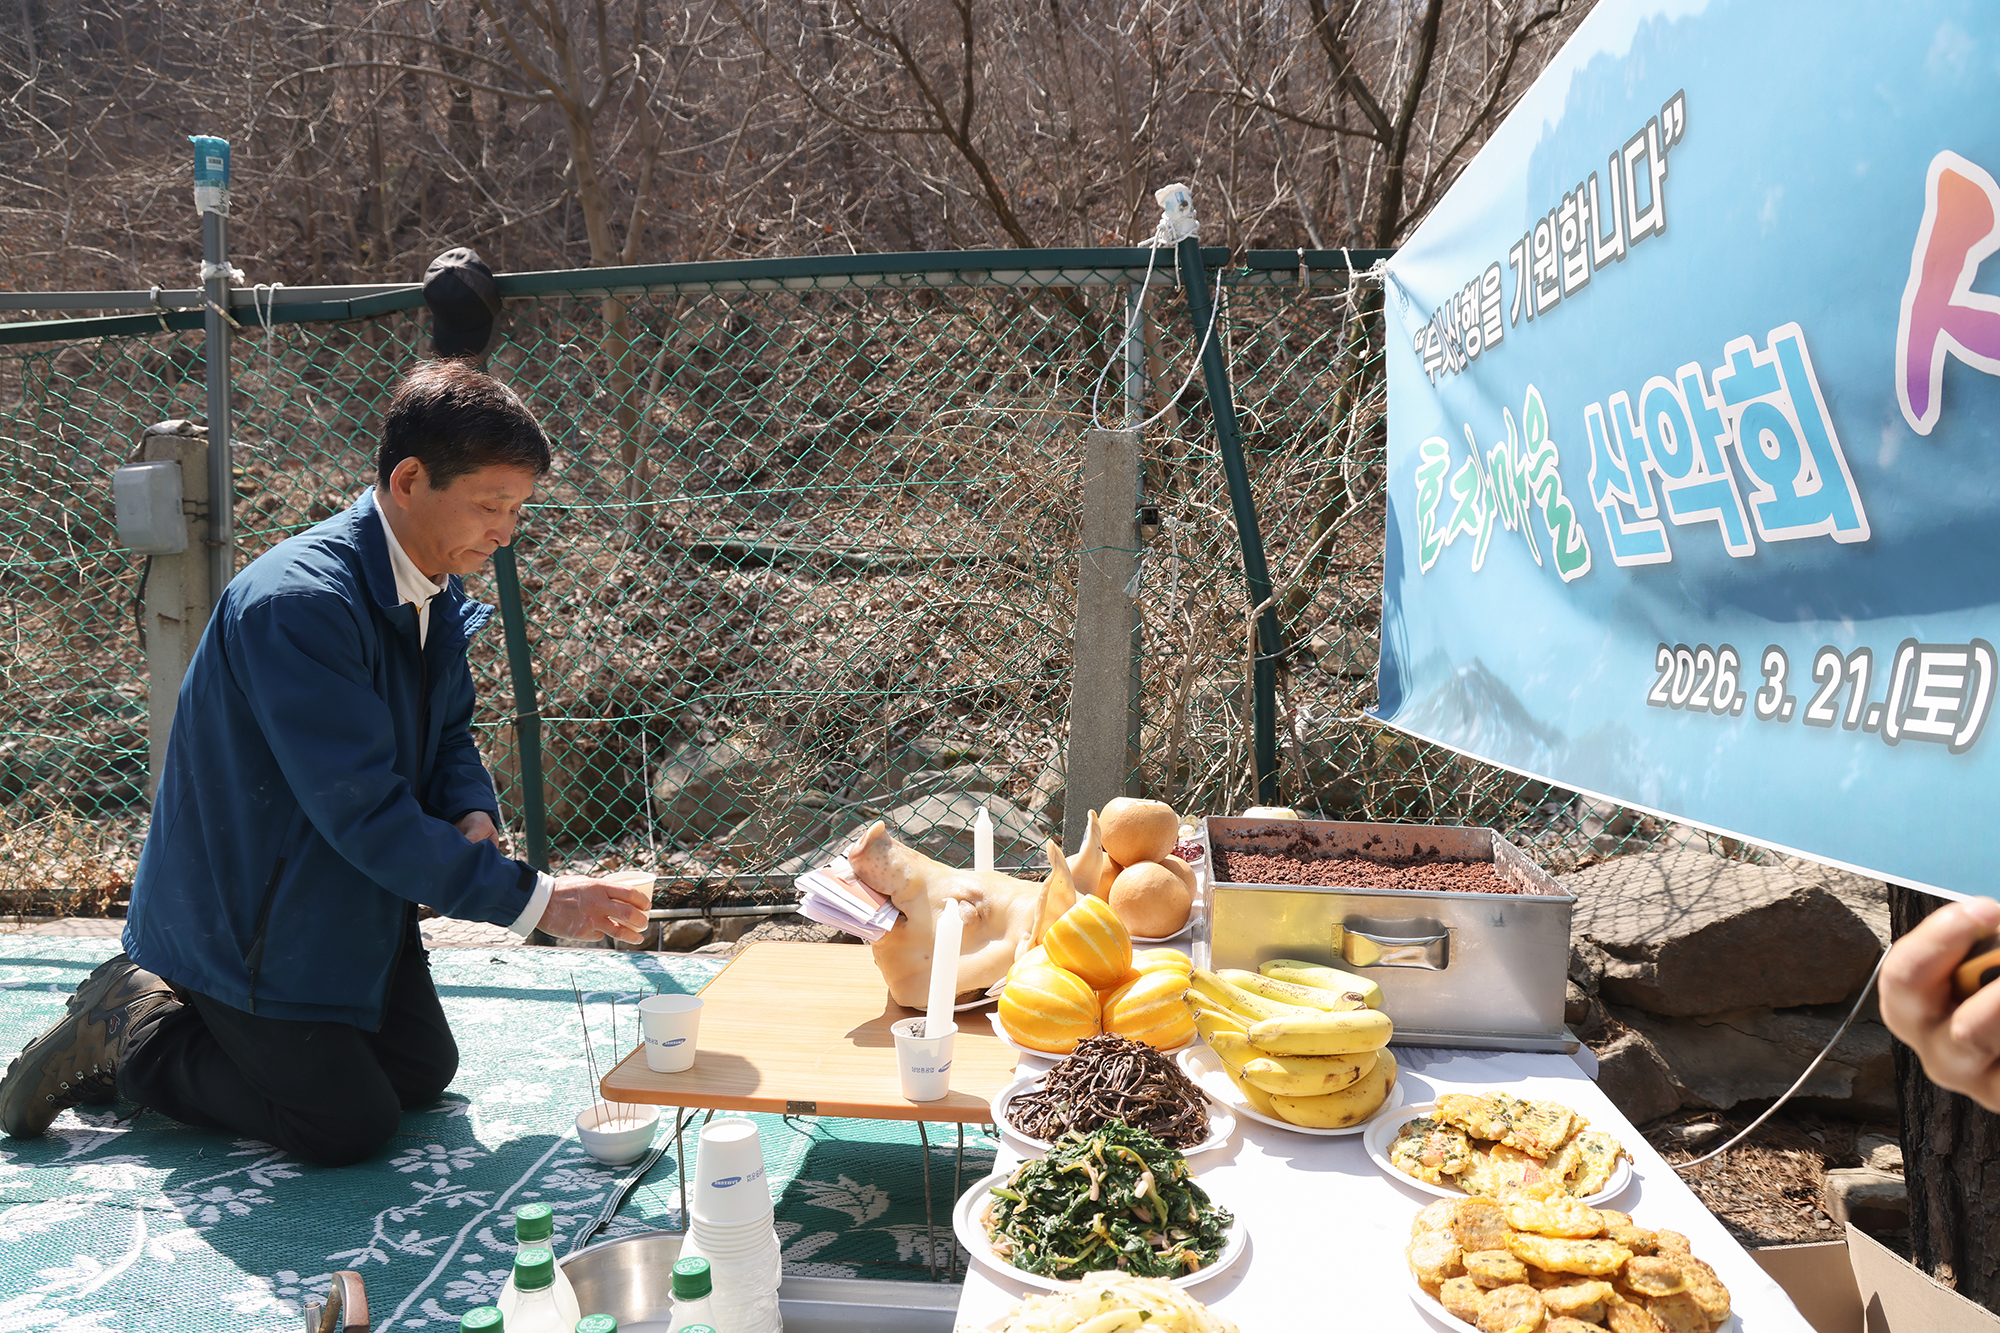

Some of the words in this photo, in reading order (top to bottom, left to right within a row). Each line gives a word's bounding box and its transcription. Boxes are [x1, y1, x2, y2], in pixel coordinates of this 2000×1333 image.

[1509, 88, 1685, 329] 기원합니다”
[1584, 321, 1871, 567] 산악회
[1647, 642, 1747, 716] 2026.
[1754, 644, 1797, 723] 3.
